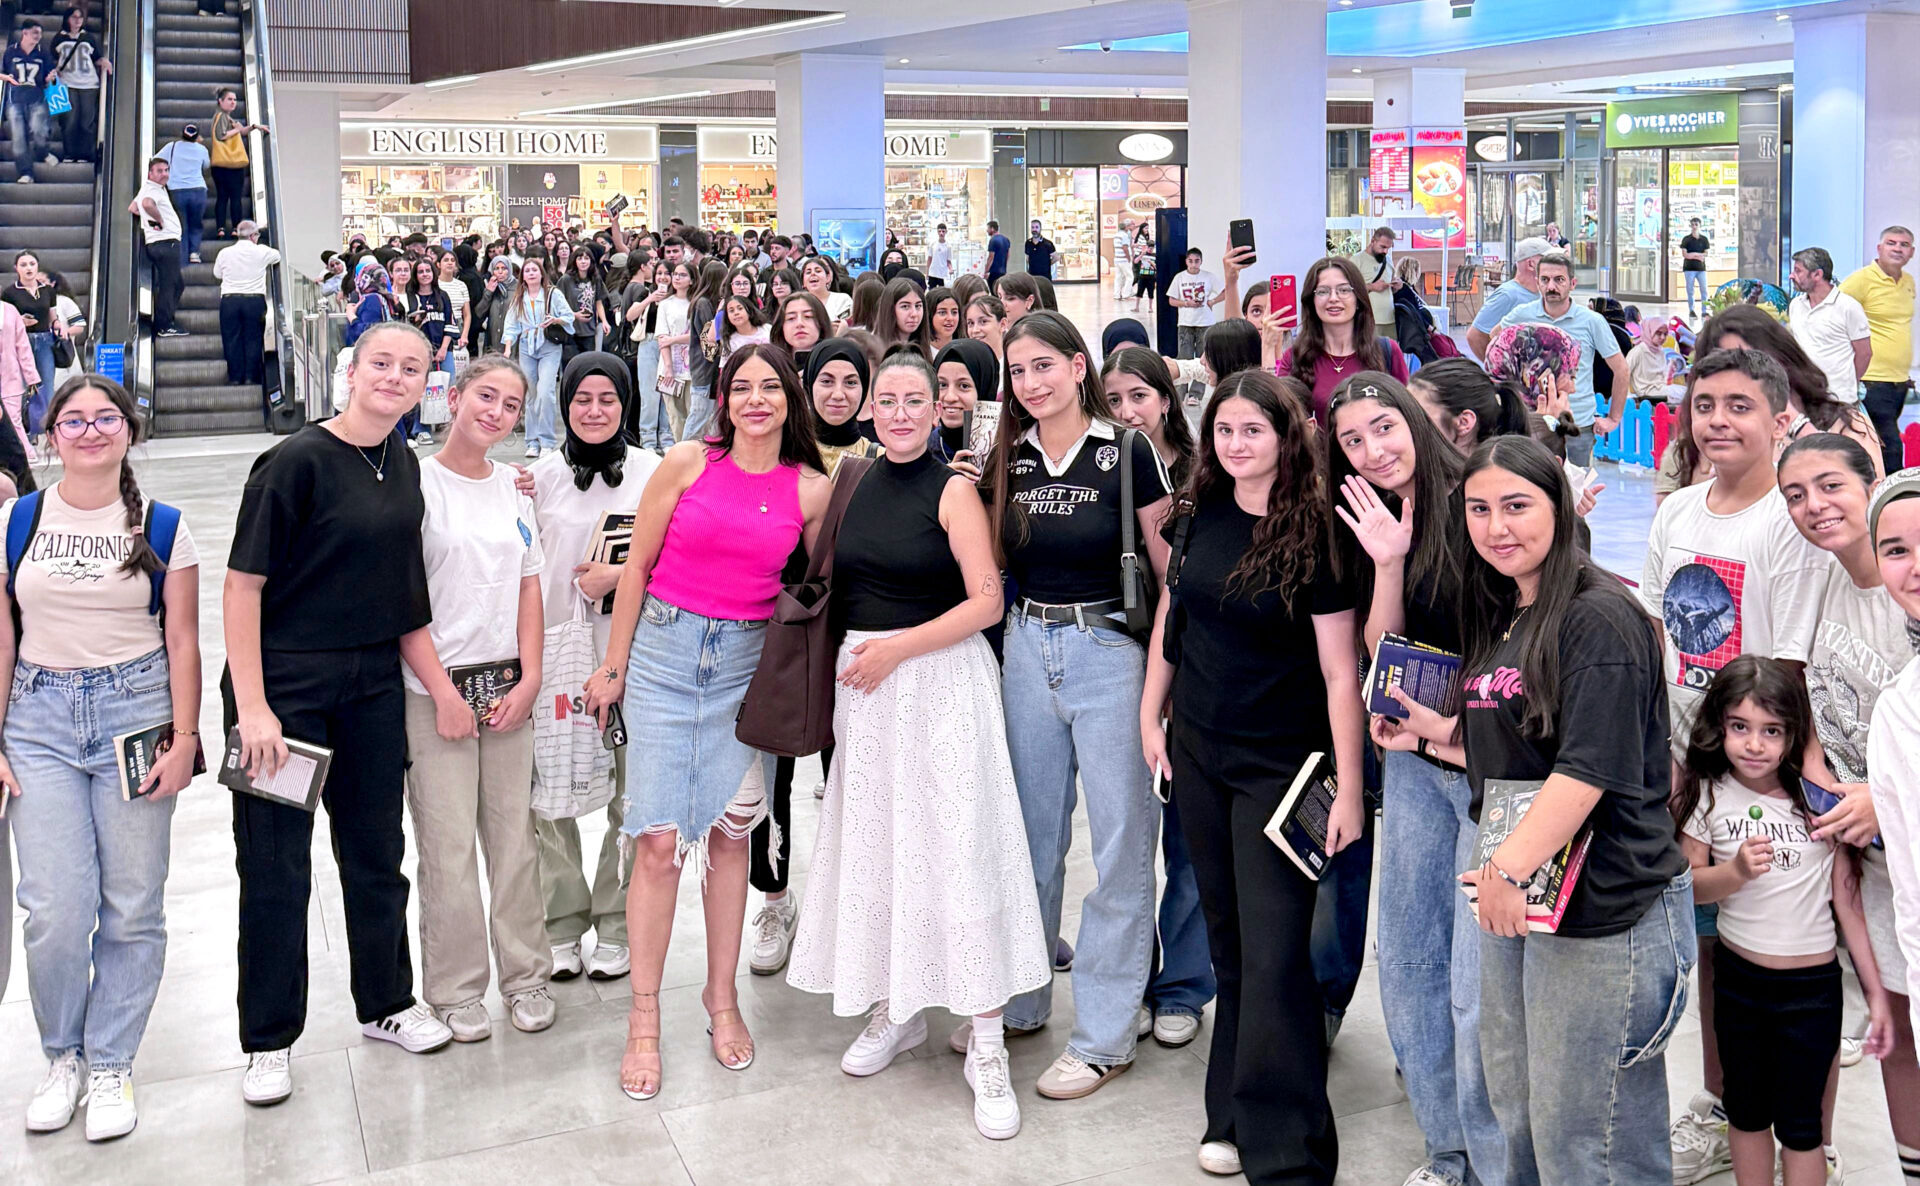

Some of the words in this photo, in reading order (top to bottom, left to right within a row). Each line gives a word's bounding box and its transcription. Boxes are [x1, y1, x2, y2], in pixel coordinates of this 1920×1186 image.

[15, 63, 39, 86] 17
[1633, 115, 1666, 128] YVES
[1669, 111, 1725, 126] ROCHER
[372, 129, 505, 155] ENGLISH
[517, 131, 607, 155] HOME
[537, 197, 567, 206] HOME
[1015, 467, 1028, 475] 89
[1013, 488, 1066, 503] FORGET
[1069, 490, 1100, 502] THE
[1028, 502, 1076, 516] RULES
[1725, 818, 1810, 844] WEDNES
